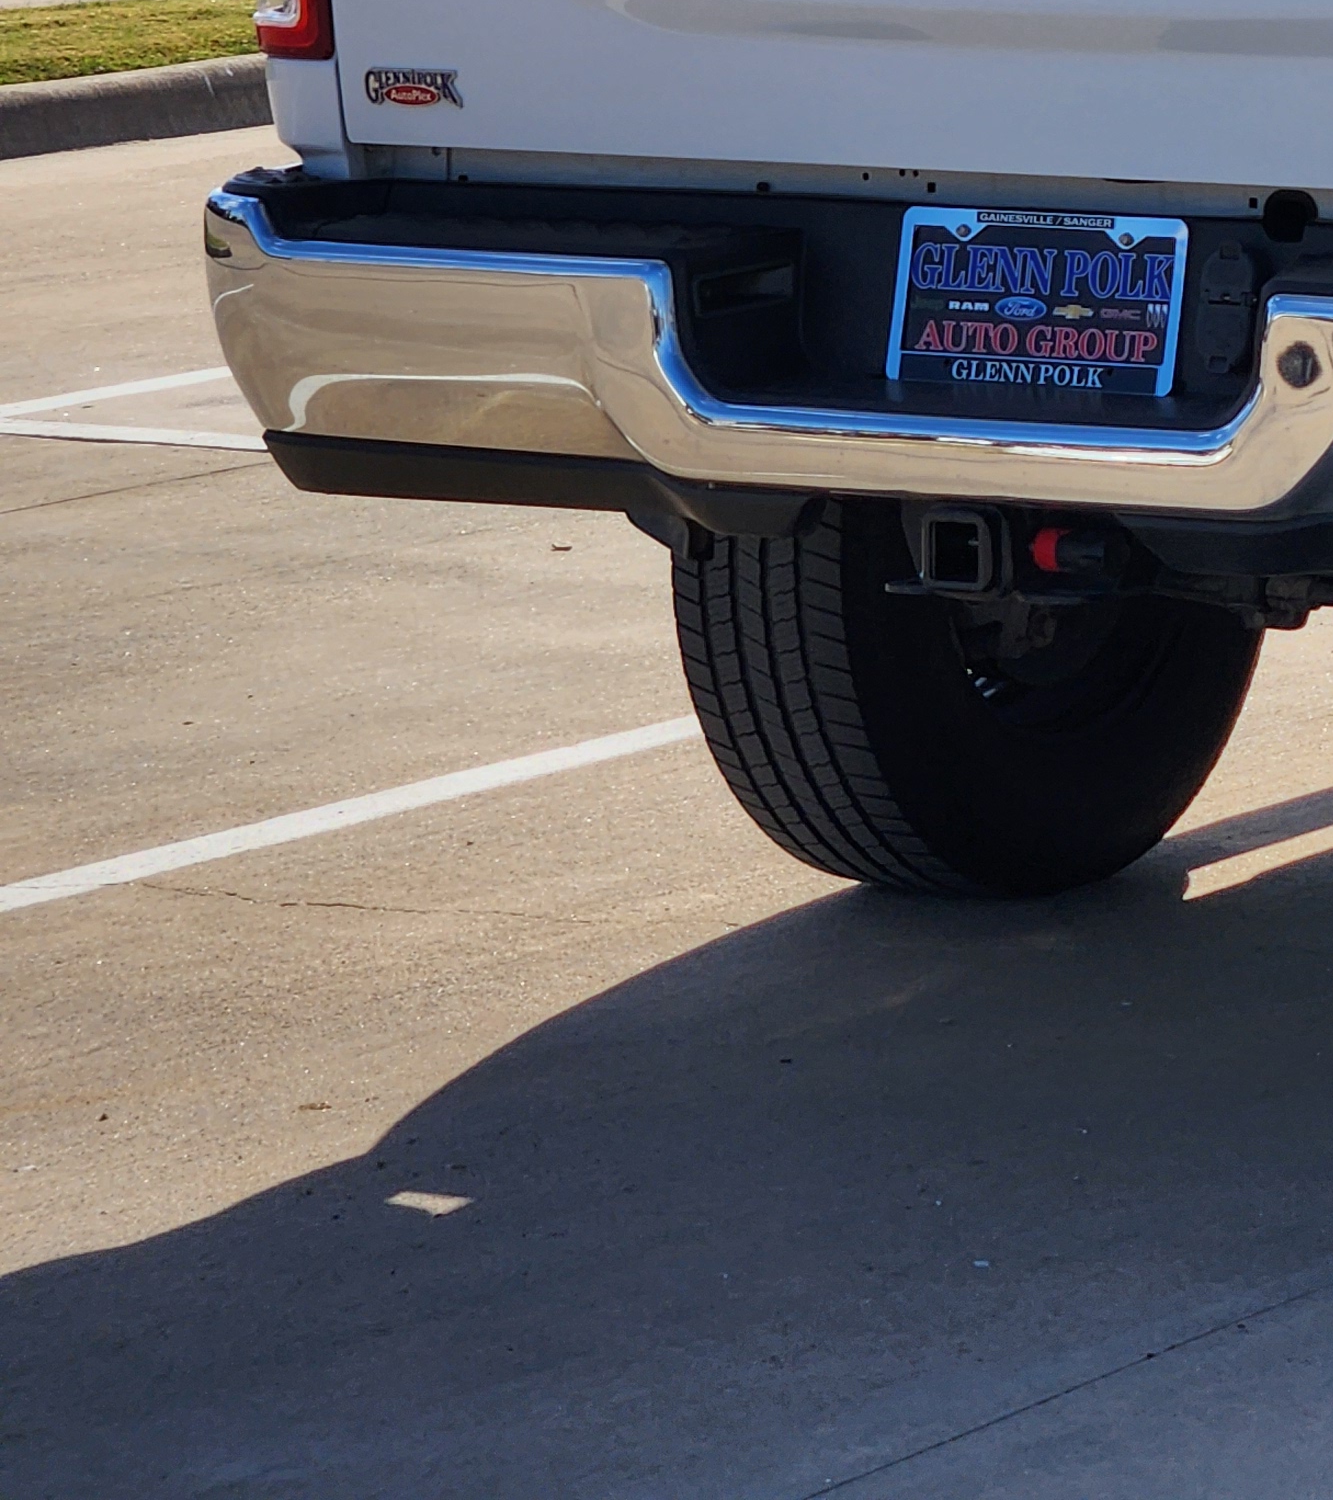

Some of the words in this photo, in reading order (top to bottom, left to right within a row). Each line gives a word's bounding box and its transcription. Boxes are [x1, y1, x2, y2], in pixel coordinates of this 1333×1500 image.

[979, 212, 1054, 225] GAINESVILLE
[1063, 216, 1113, 228] SANGER
[911, 241, 1055, 295] GLENN
[1060, 249, 1176, 301] POLK
[948, 299, 990, 313] RAM
[1003, 299, 1038, 318] Ford
[914, 318, 1018, 356] AUTO
[1025, 325, 1158, 363] GROUP
[951, 359, 1038, 386] GLENN
[1038, 364, 1104, 389] POLK
